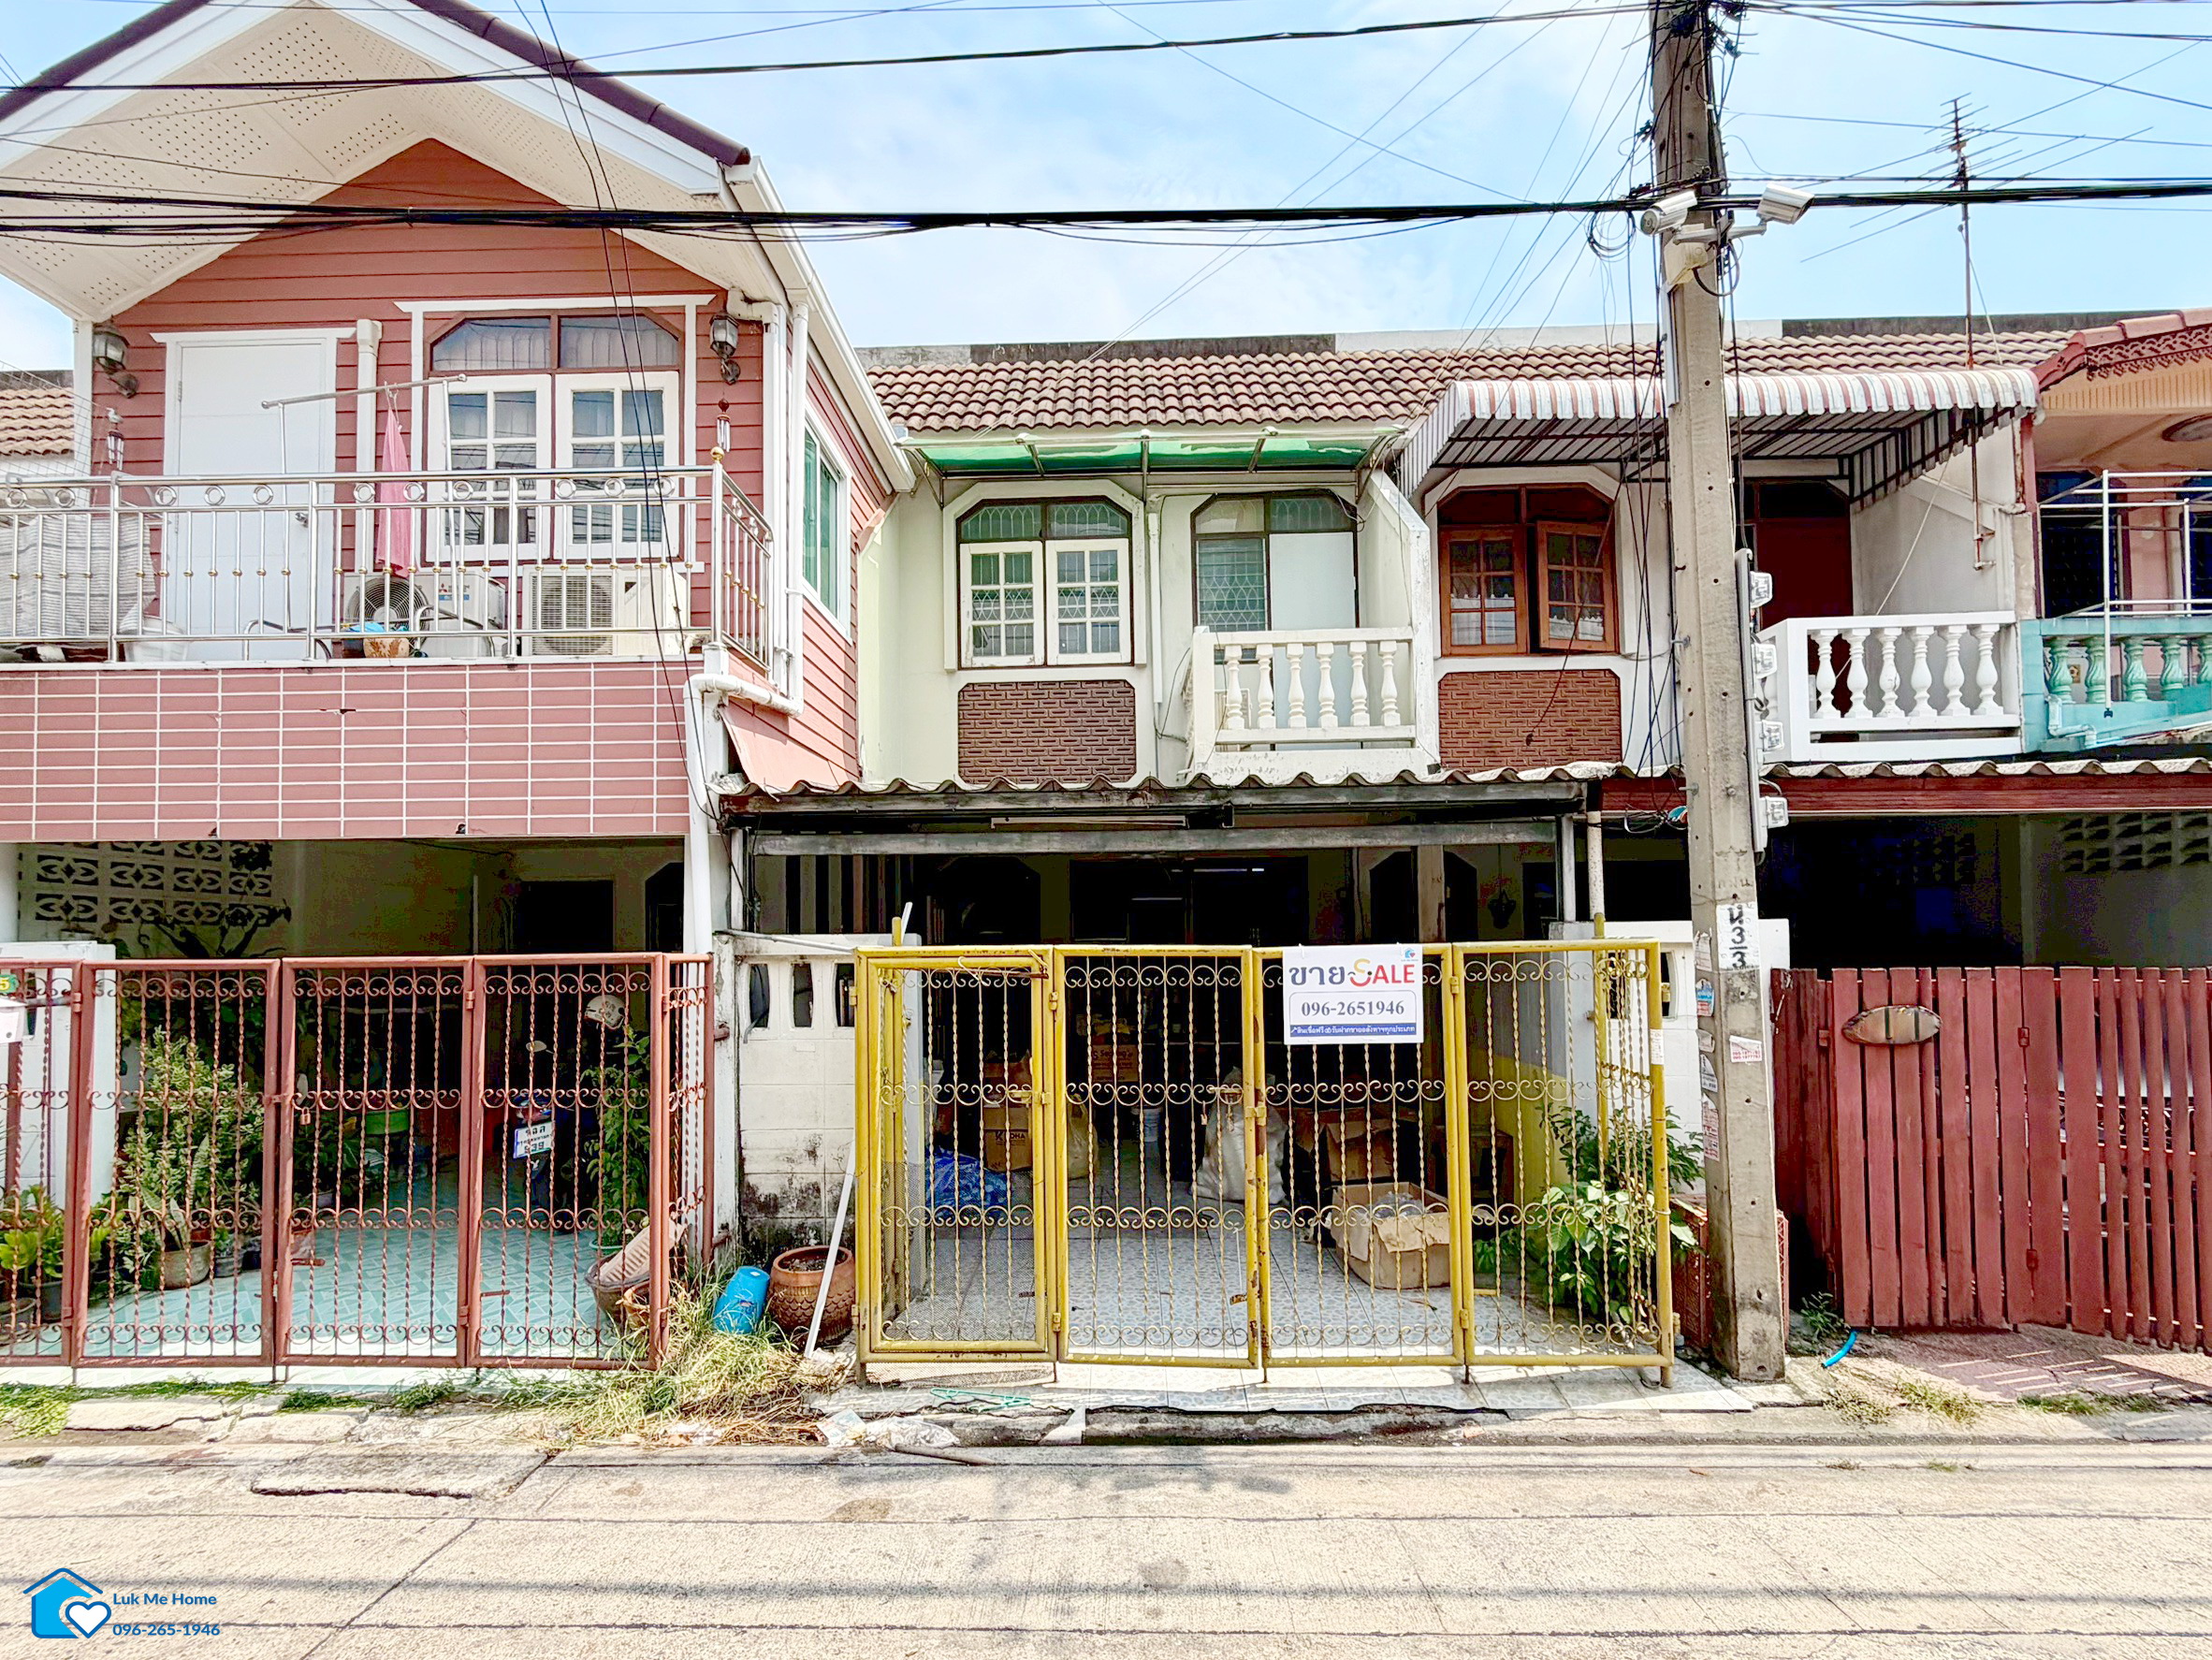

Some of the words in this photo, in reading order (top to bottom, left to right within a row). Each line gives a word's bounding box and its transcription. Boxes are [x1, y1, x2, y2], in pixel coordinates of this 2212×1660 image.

[1289, 966, 1345, 985] ขาย
[1348, 958, 1415, 987] SALE
[1302, 1000, 1404, 1016] 096-2651946
